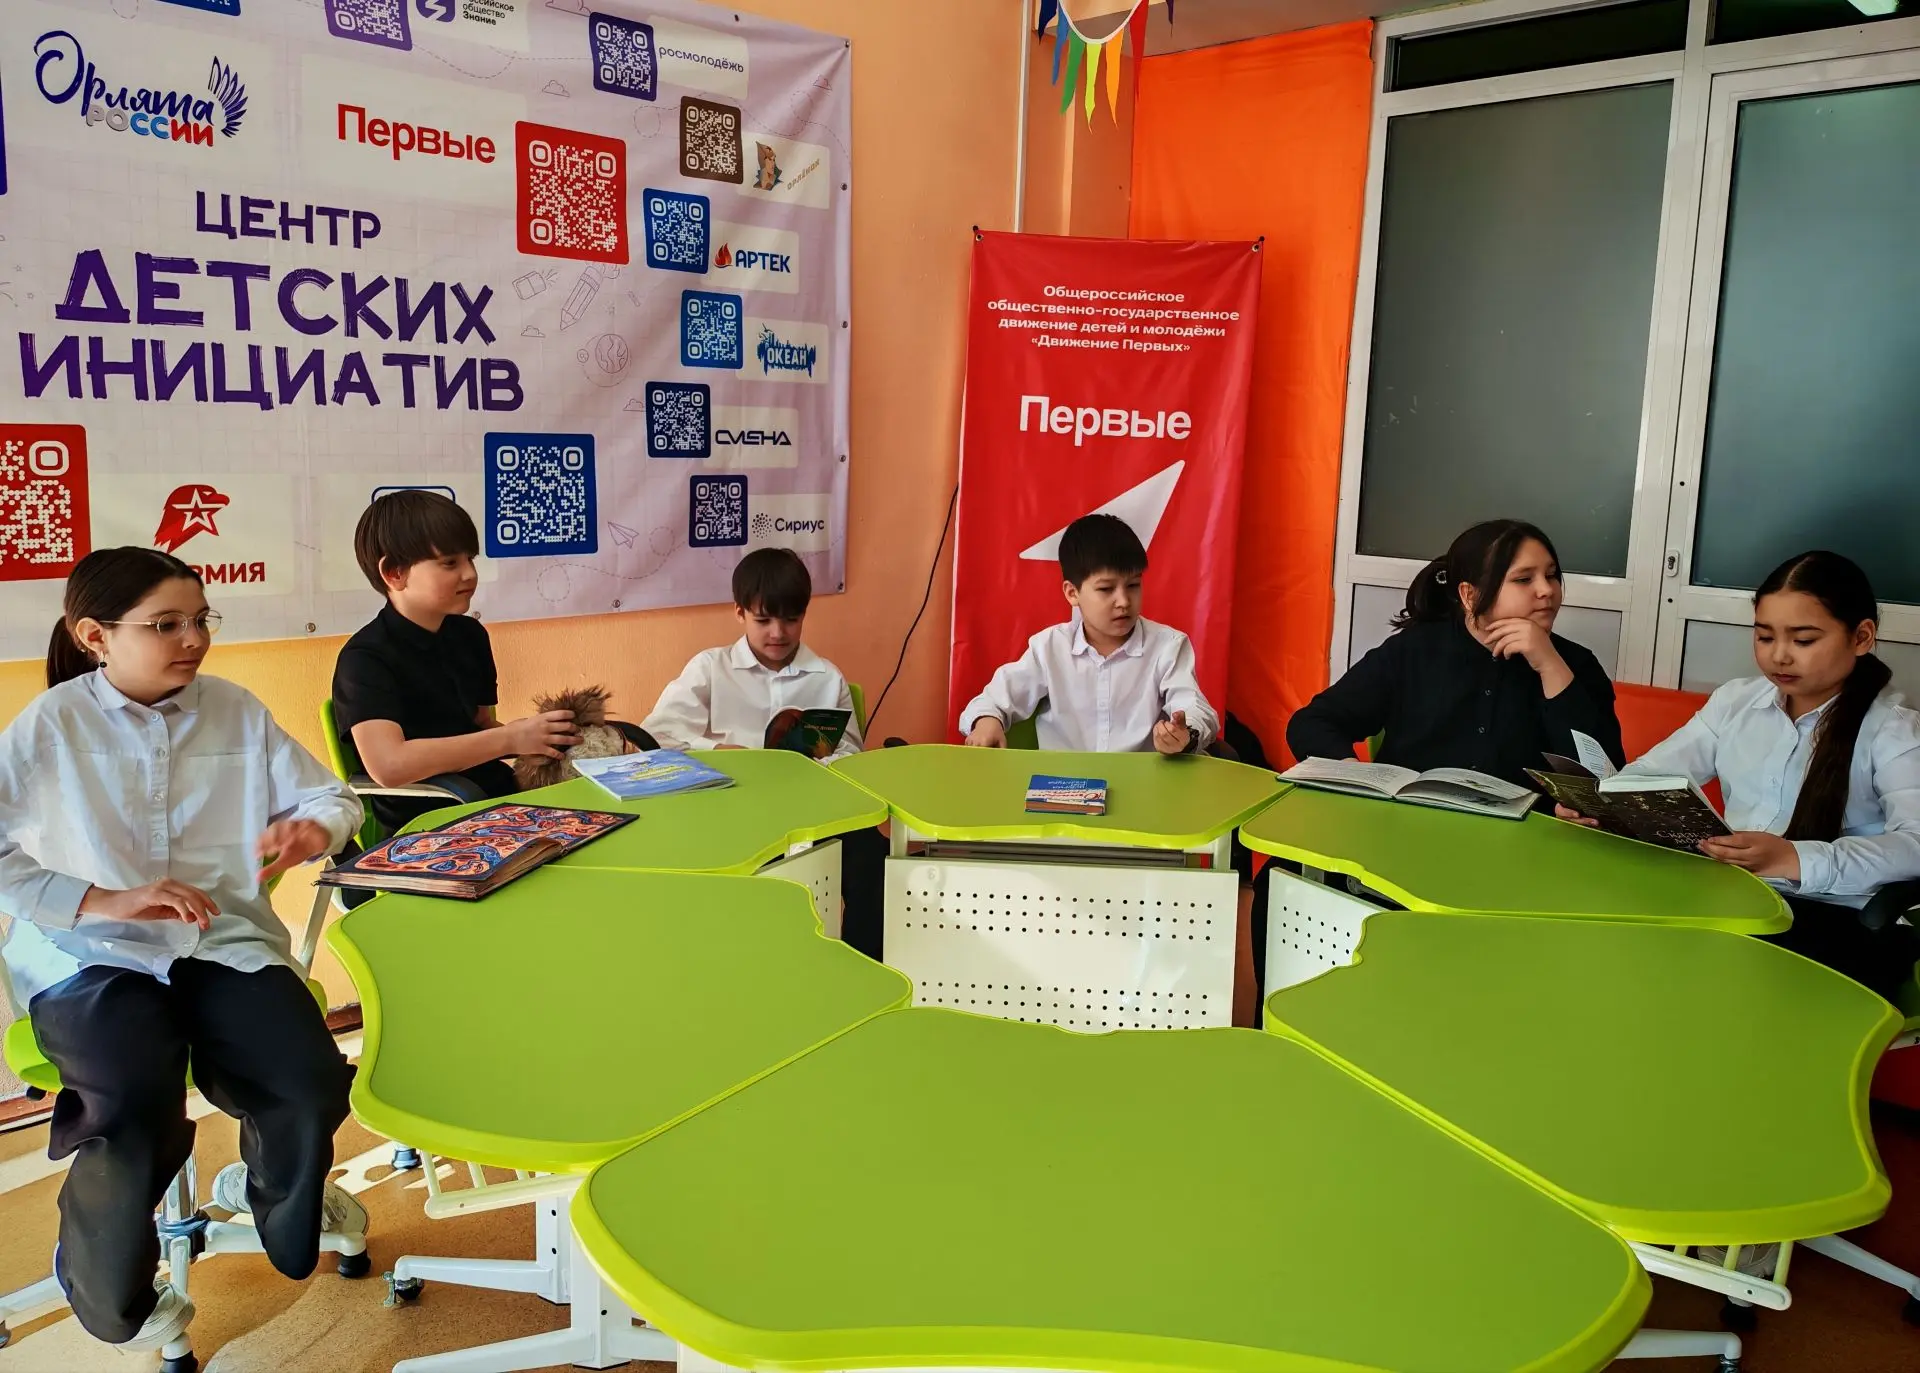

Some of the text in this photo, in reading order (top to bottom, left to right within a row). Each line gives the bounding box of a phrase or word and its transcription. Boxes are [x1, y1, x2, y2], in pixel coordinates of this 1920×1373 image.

[463, 3, 505, 19] общество
[463, 10, 496, 26] Знание
[659, 46, 744, 72] росмолодёжь
[34, 30, 214, 125] Орлята
[338, 103, 495, 163] Первые
[196, 191, 381, 249] ЦЕНТР
[735, 249, 791, 273] АРТЕК
[55, 249, 496, 346] ДЕТСКИХ
[1043, 285, 1185, 302] Общероссийское
[987, 299, 1240, 321] общественно-государственное
[998, 318, 1226, 337] движение детей и молодёжи
[1031, 334, 1191, 353] «Движение Первых»
[766, 347, 807, 366] ОКЕАН
[19, 332, 524, 411] ИНИЦИАТИВ
[1019, 395, 1192, 447] Первые
[715, 429, 792, 445] СМЕНА
[775, 517, 825, 534] Сириус
